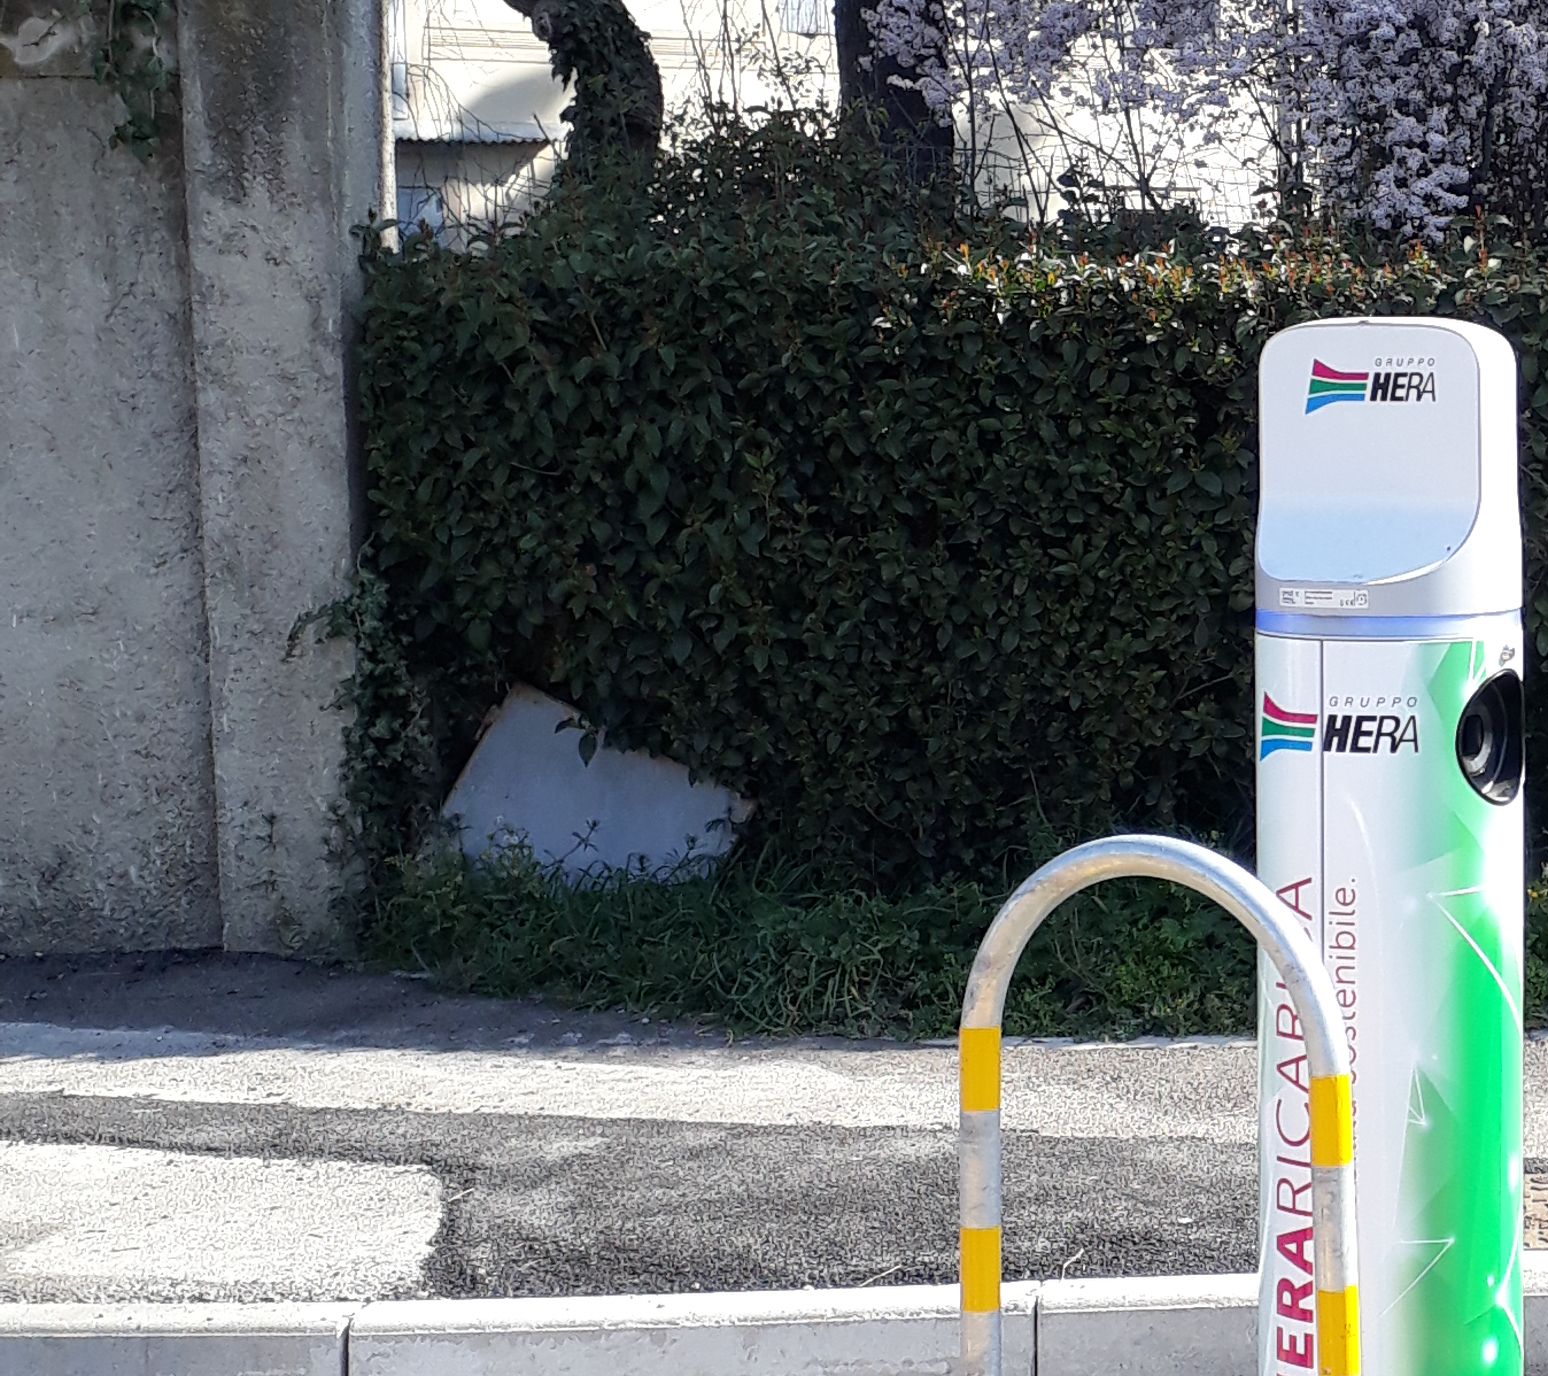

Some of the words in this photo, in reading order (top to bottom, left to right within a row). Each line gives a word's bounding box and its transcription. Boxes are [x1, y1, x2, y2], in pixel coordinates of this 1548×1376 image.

[1374, 357, 1436, 367] GRUPPO
[1369, 372, 1437, 402] HERA
[1328, 696, 1419, 708] GRUPPO
[1323, 714, 1420, 754] HERA
